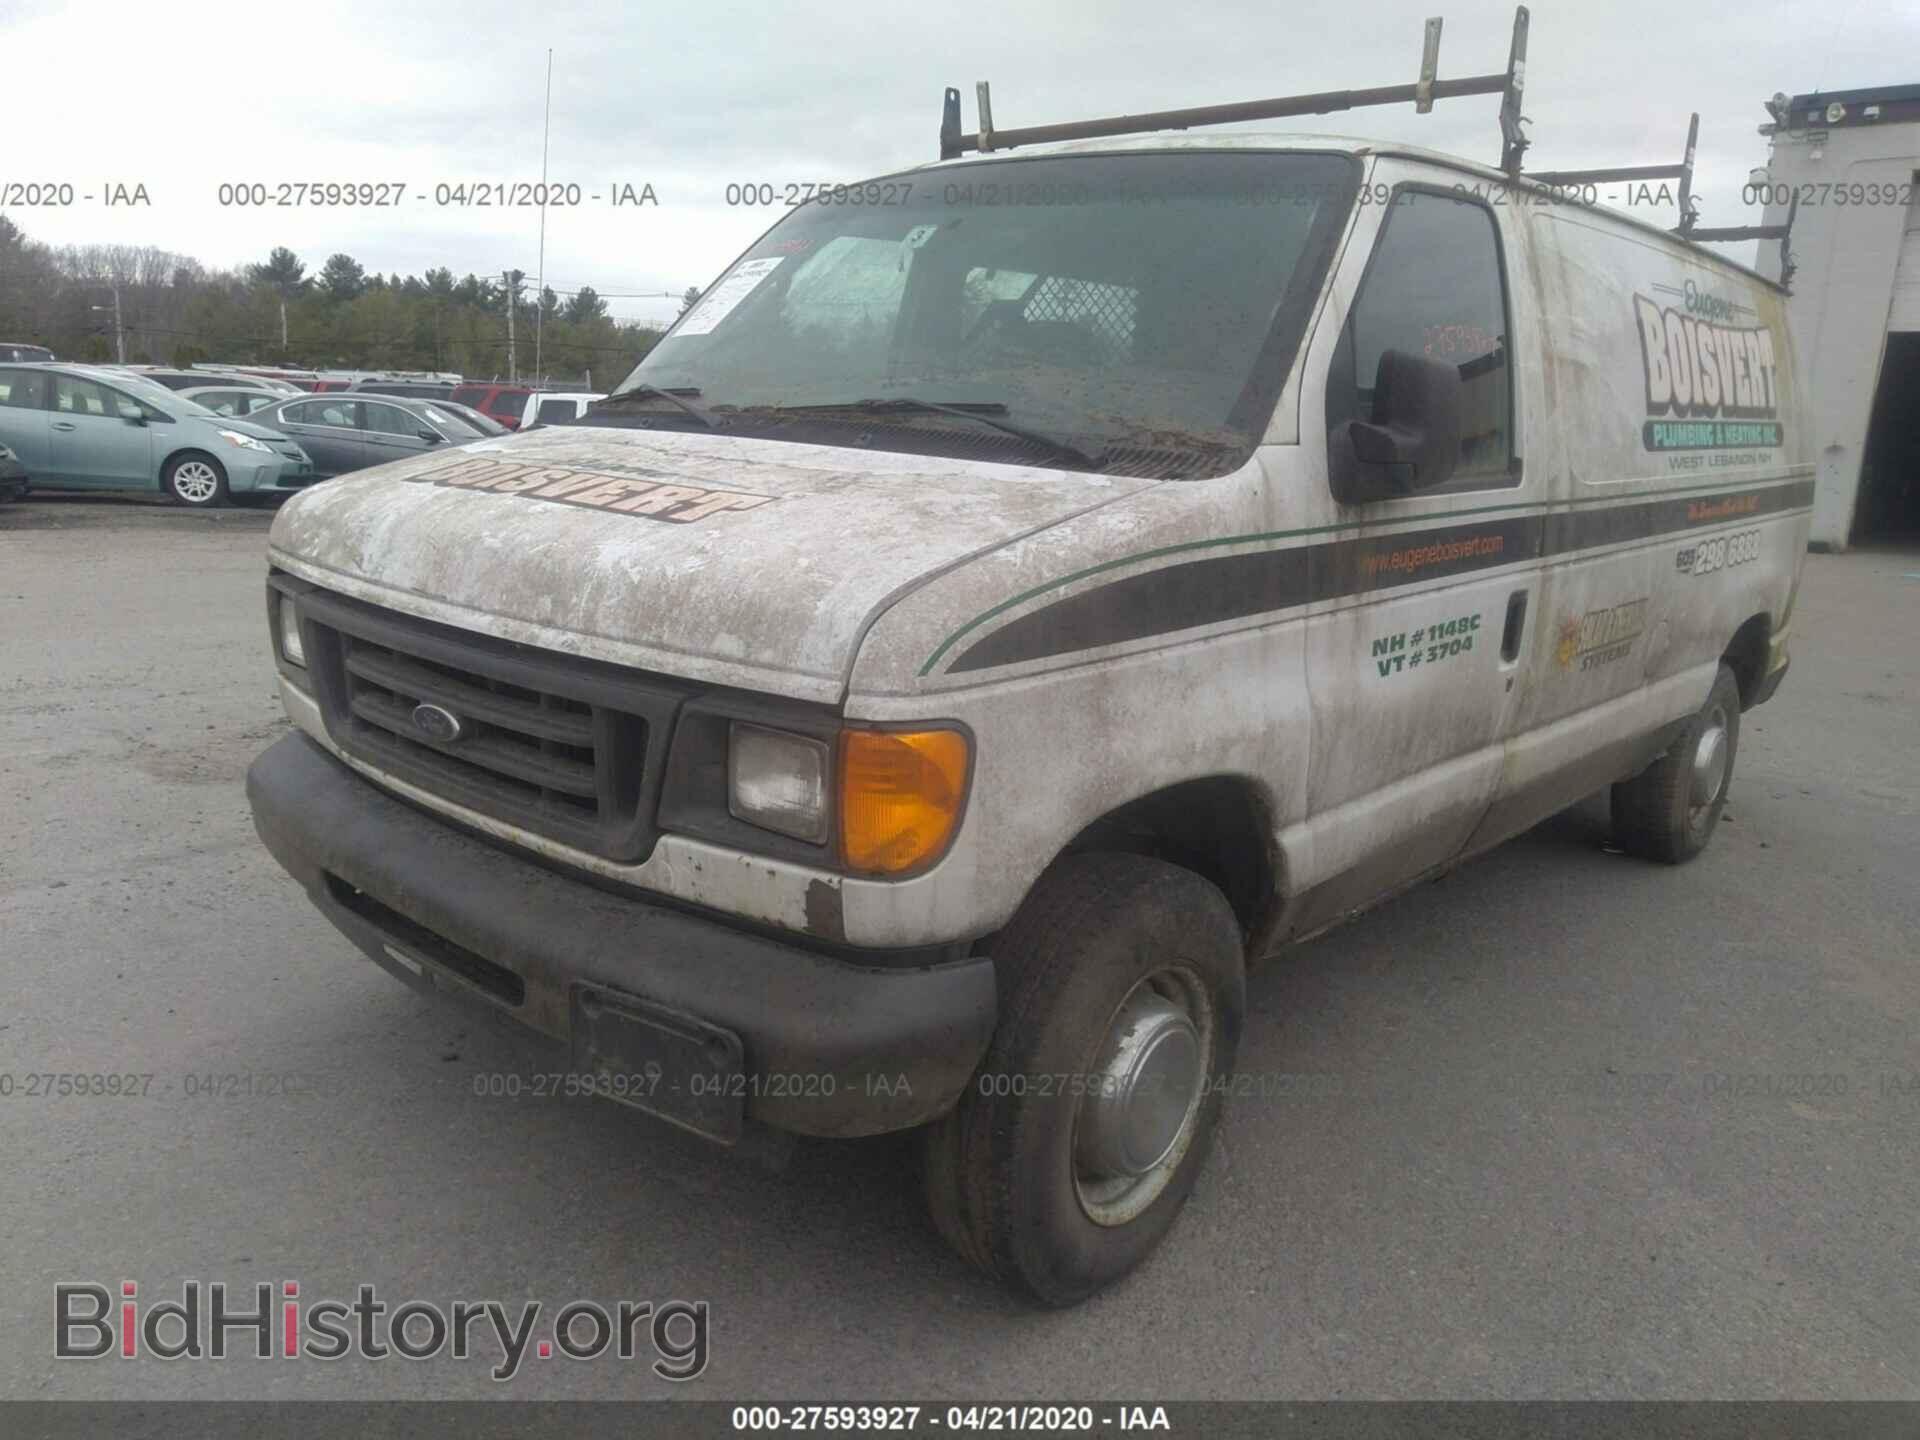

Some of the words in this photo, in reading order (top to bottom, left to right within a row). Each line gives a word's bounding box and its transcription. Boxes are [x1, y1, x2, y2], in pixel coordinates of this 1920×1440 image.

[1633, 292, 1777, 418] BOISVERT
[1653, 422, 1714, 448] PLUMBING
[1668, 455, 1704, 470] WEST
[1708, 453, 1756, 466] LEBANON
[1372, 633, 1406, 657] NH
[1410, 628, 1425, 648] #
[1428, 614, 1481, 641] 1148C
[1377, 654, 1406, 677] VT
[1409, 650, 1423, 670] #
[1426, 635, 1473, 663] 3704
